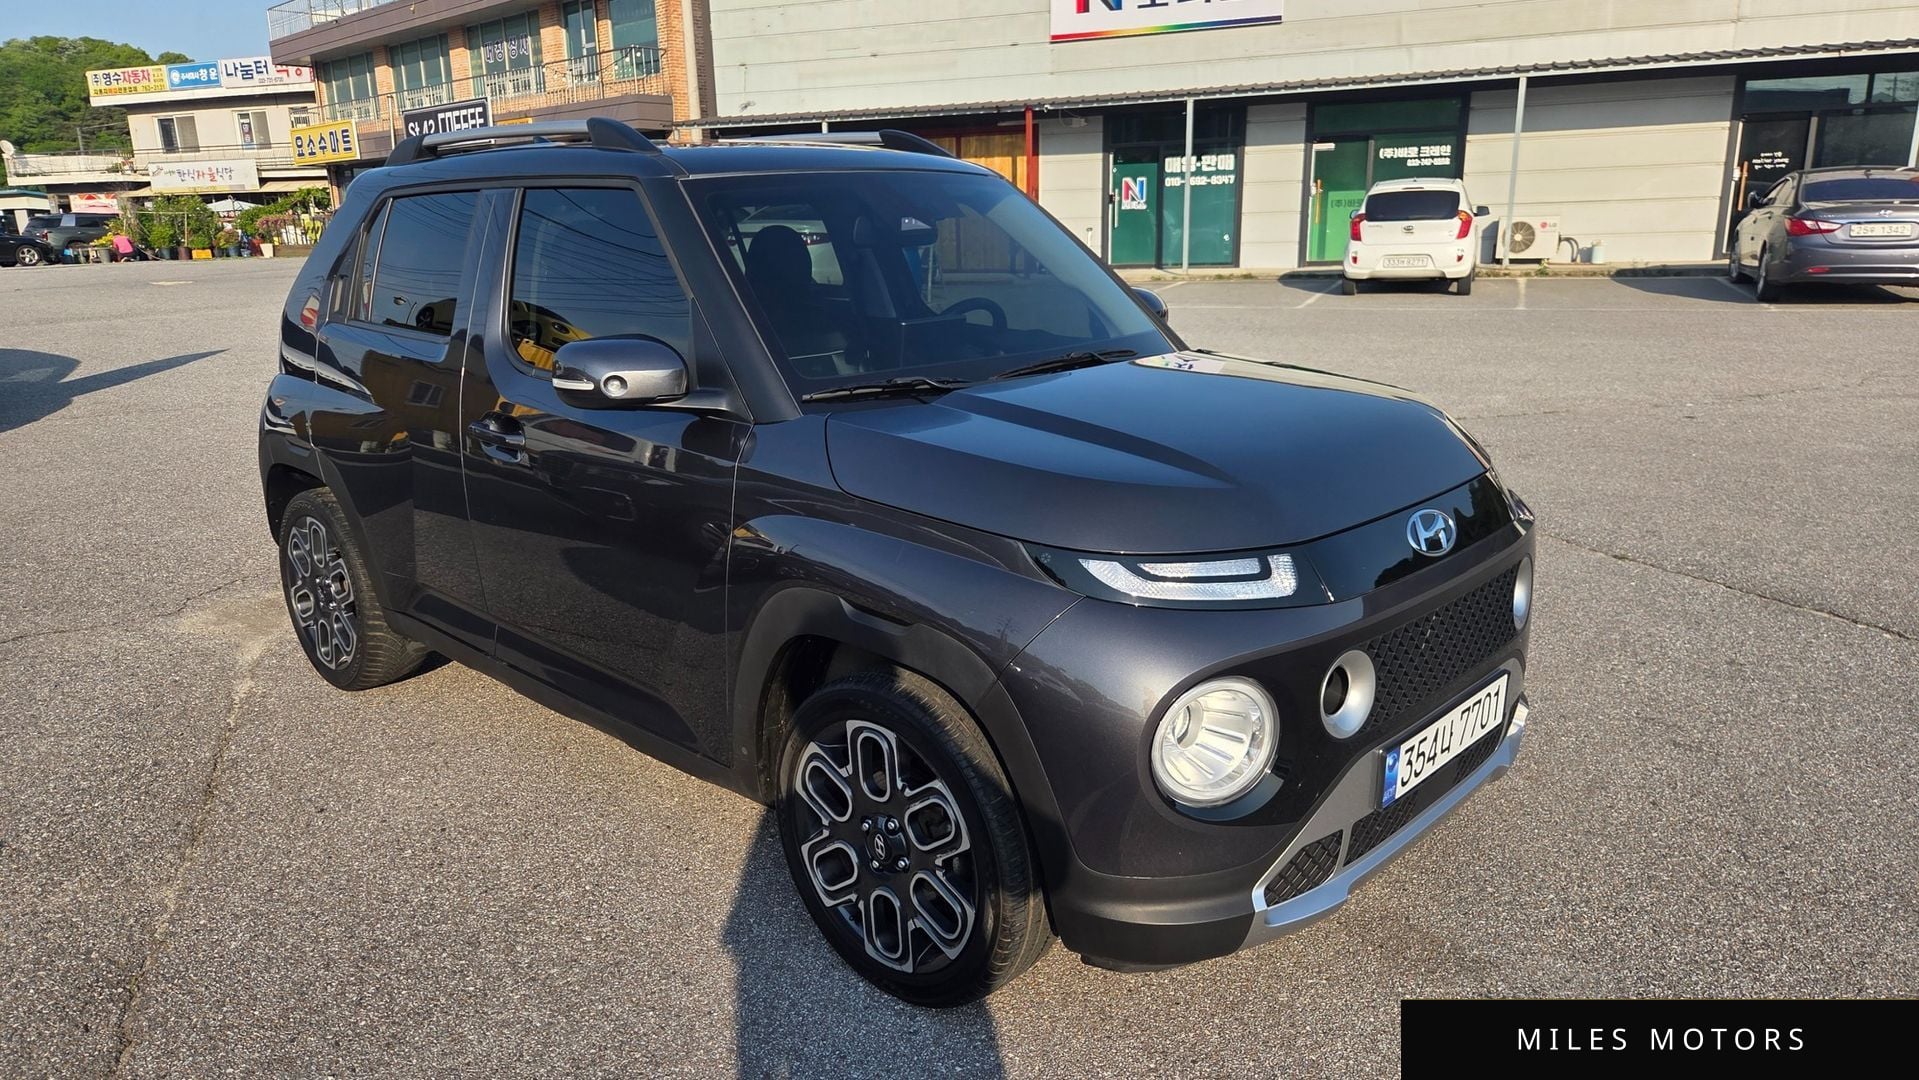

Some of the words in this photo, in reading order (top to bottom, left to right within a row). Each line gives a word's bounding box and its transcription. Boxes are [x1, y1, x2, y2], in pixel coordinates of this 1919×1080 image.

[102, 68, 151, 86] 영수자동차
[224, 60, 268, 80] 나눔터
[437, 107, 484, 134] COFFEE
[295, 128, 353, 158] 요소수마트
[1420, 144, 1452, 157] 크레인
[1164, 174, 1235, 187] 010-692-8347
[1400, 719, 1454, 788] 354나
[1459, 684, 1501, 746] 7701
